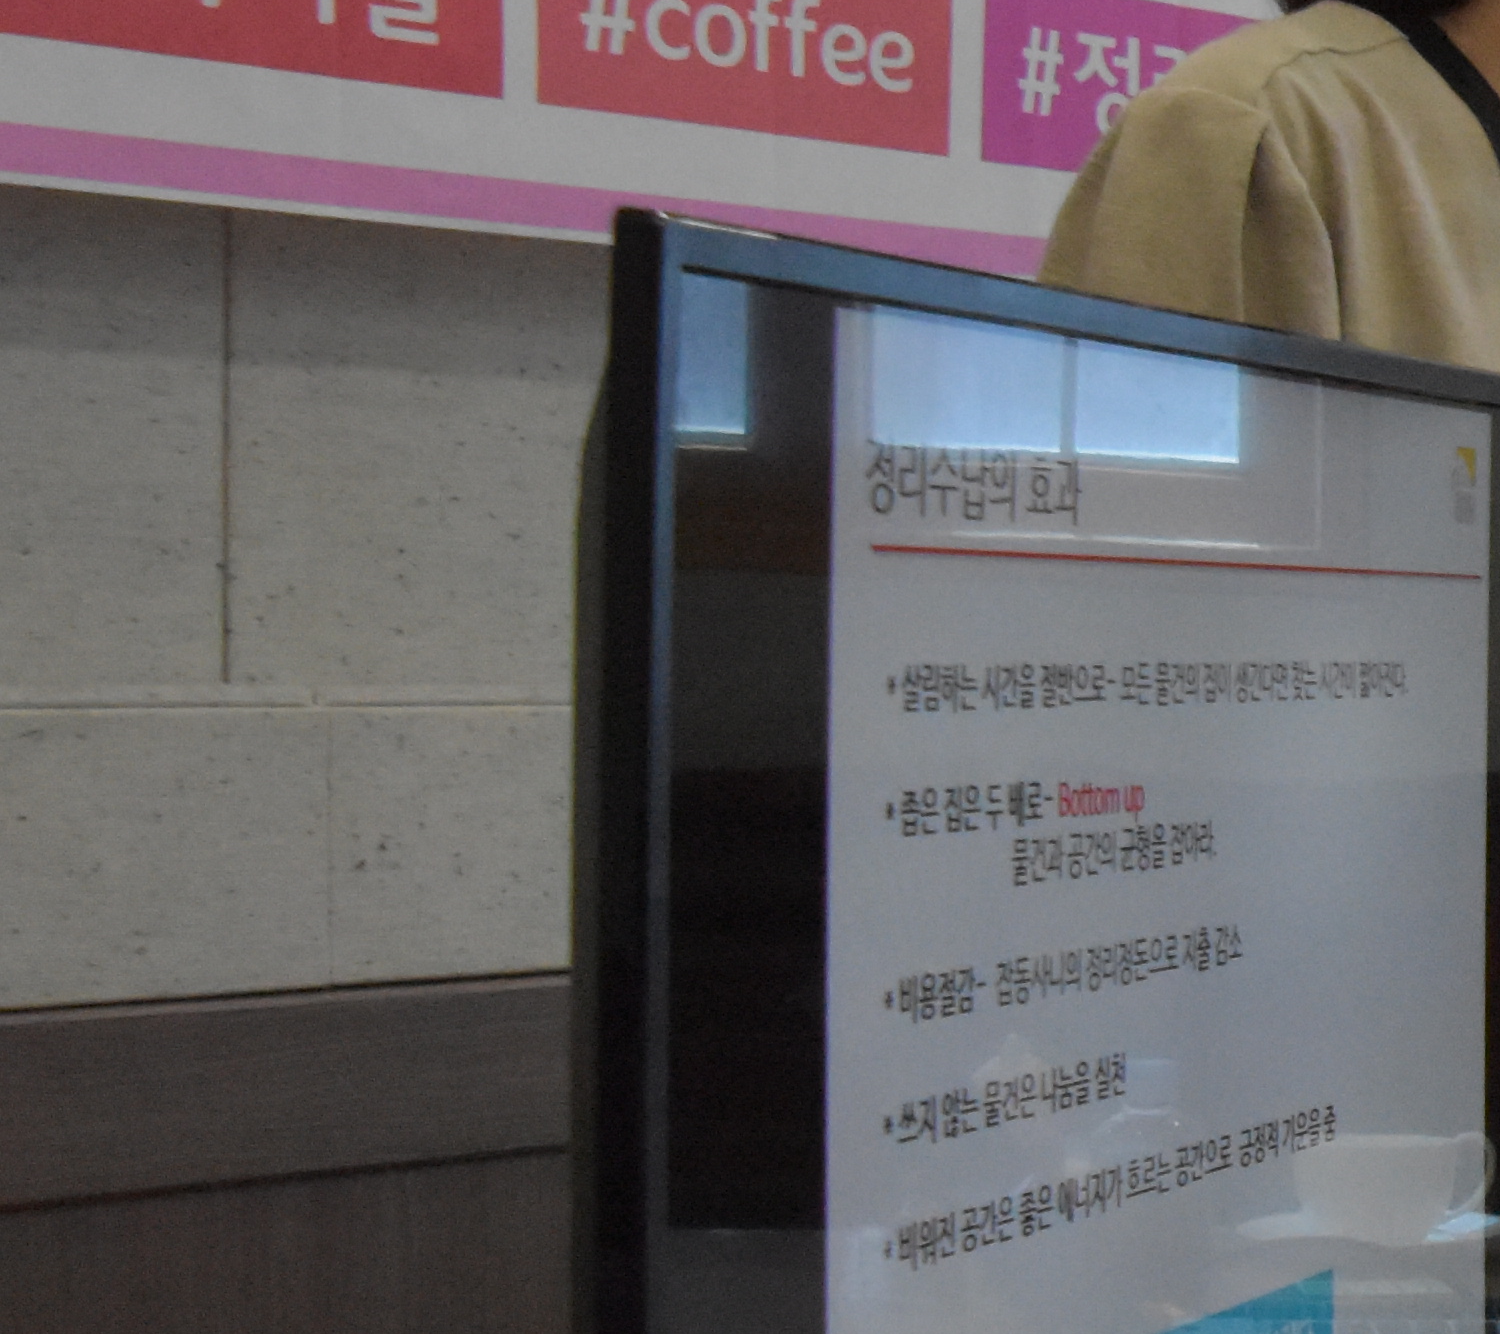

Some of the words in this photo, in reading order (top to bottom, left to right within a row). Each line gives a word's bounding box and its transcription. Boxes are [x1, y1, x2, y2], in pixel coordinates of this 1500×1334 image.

[1017, 26, 1188, 136] #정
[866, 439, 1016, 523] 정리수납의
[1026, 455, 1082, 525] 효과
[902, 663, 978, 713] 살림하는
[982, 663, 1035, 713] 시간을
[1120, 662, 1152, 705] 모든
[1155, 662, 1201, 706] 물건의
[1291, 660, 1318, 702] 찾는
[943, 784, 981, 834] 집은
[985, 784, 1005, 831] 두
[1058, 782, 1120, 818] Bottom
[1123, 784, 1146, 823] up
[1012, 834, 1063, 887] 물건과
[1068, 831, 1117, 880] 공간의
[1119, 822, 1167, 872] 균형을
[995, 947, 1083, 1007] 잡동사니의
[1182, 925, 1211, 973] 지출
[1214, 922, 1244, 967] 감소
[896, 1093, 938, 1144] 쓰지
[941, 1085, 979, 1139] 않는
[982, 1071, 1038, 1129] 물건은
[1041, 1059, 1090, 1114] 나눔을
[1094, 1051, 1128, 1100] 실천
[896, 1204, 957, 1272] 비워진
[958, 1194, 1014, 1253] 공간은
[1018, 1182, 1054, 1240] 좋은
[1056, 1163, 1124, 1223] 에너지가
[1126, 1153, 1173, 1199] 흐르는
[1174, 1133, 1233, 1188] 공간으로
[1238, 1117, 1281, 1168] 긍정적
